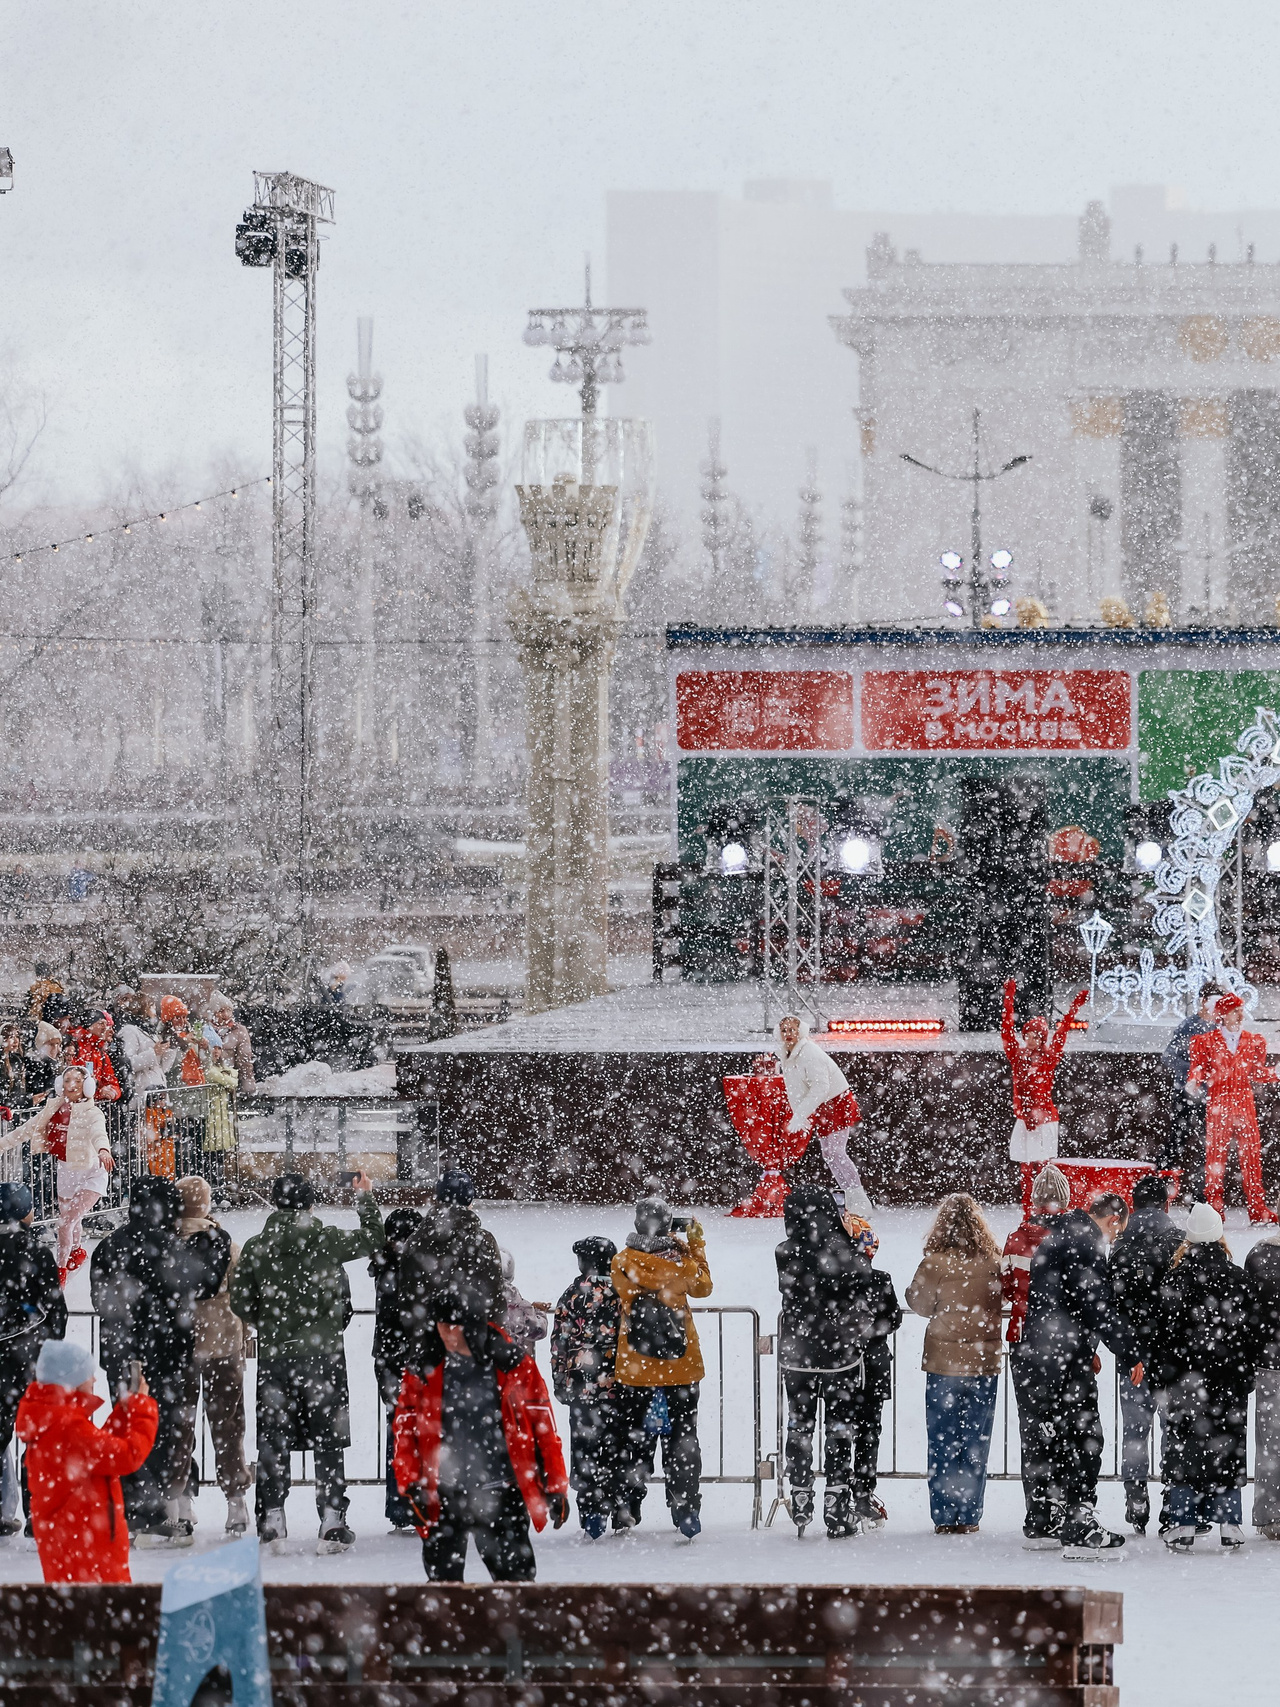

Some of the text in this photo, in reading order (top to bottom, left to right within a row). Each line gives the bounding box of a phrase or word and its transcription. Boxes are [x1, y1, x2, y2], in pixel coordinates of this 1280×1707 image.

[925, 679, 1076, 715] ЗИМА
[924, 721, 1081, 740] В МОСКВЕ
[1039, 1421, 1056, 1437] 13
